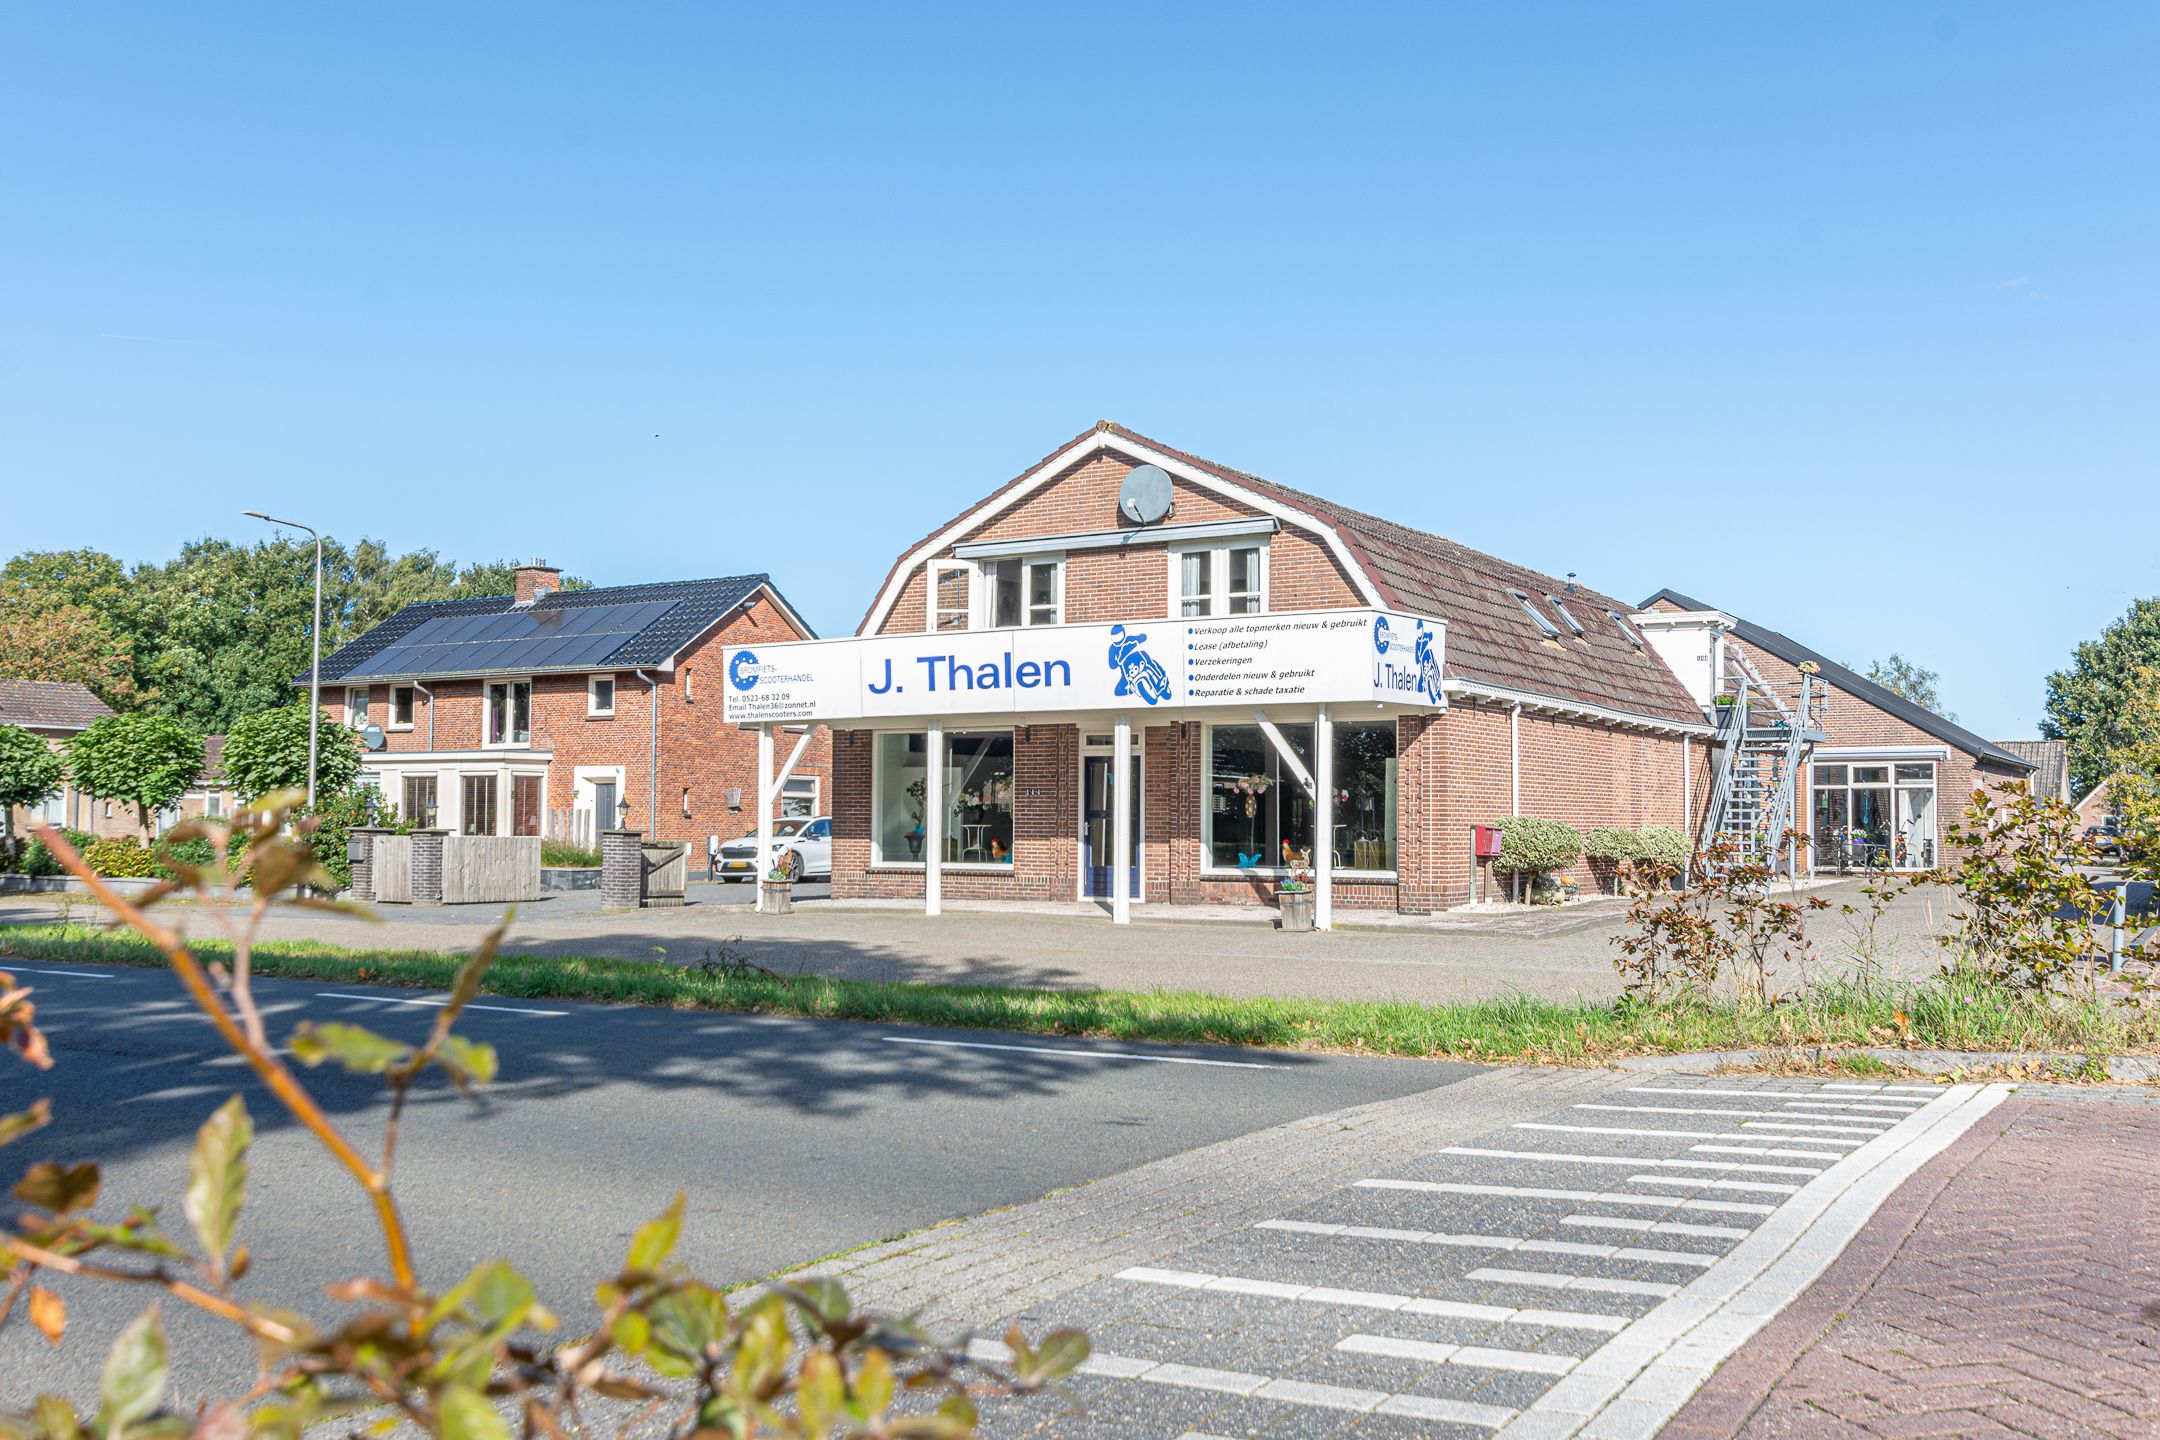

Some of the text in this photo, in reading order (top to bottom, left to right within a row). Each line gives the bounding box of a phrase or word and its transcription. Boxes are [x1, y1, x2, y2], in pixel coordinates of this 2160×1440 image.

[1194, 627, 1227, 635] Verkoop
[1246, 623, 1291, 633] topmerken
[1293, 622, 1319, 630] nieuw
[1330, 619, 1367, 630] gebruikt
[1194, 640, 1268, 650] Lease (afbetaling)
[1195, 657, 1252, 666] Verzekeringen
[760, 674, 814, 684] SCOOTERHANDEL
[868, 652, 1071, 694] J. Thalen
[1195, 672, 1241, 681] Onderdelen
[1243, 671, 1268, 680] nieuw
[1279, 669, 1315, 679] gebruikt
[1374, 662, 1417, 691] J. Thalen
[1195, 689, 1234, 697] Reparatie
[1244, 686, 1273, 695] schade
[1275, 685, 1305, 694] taxatie
[729, 711, 812, 719] www.thalenscooters.com
